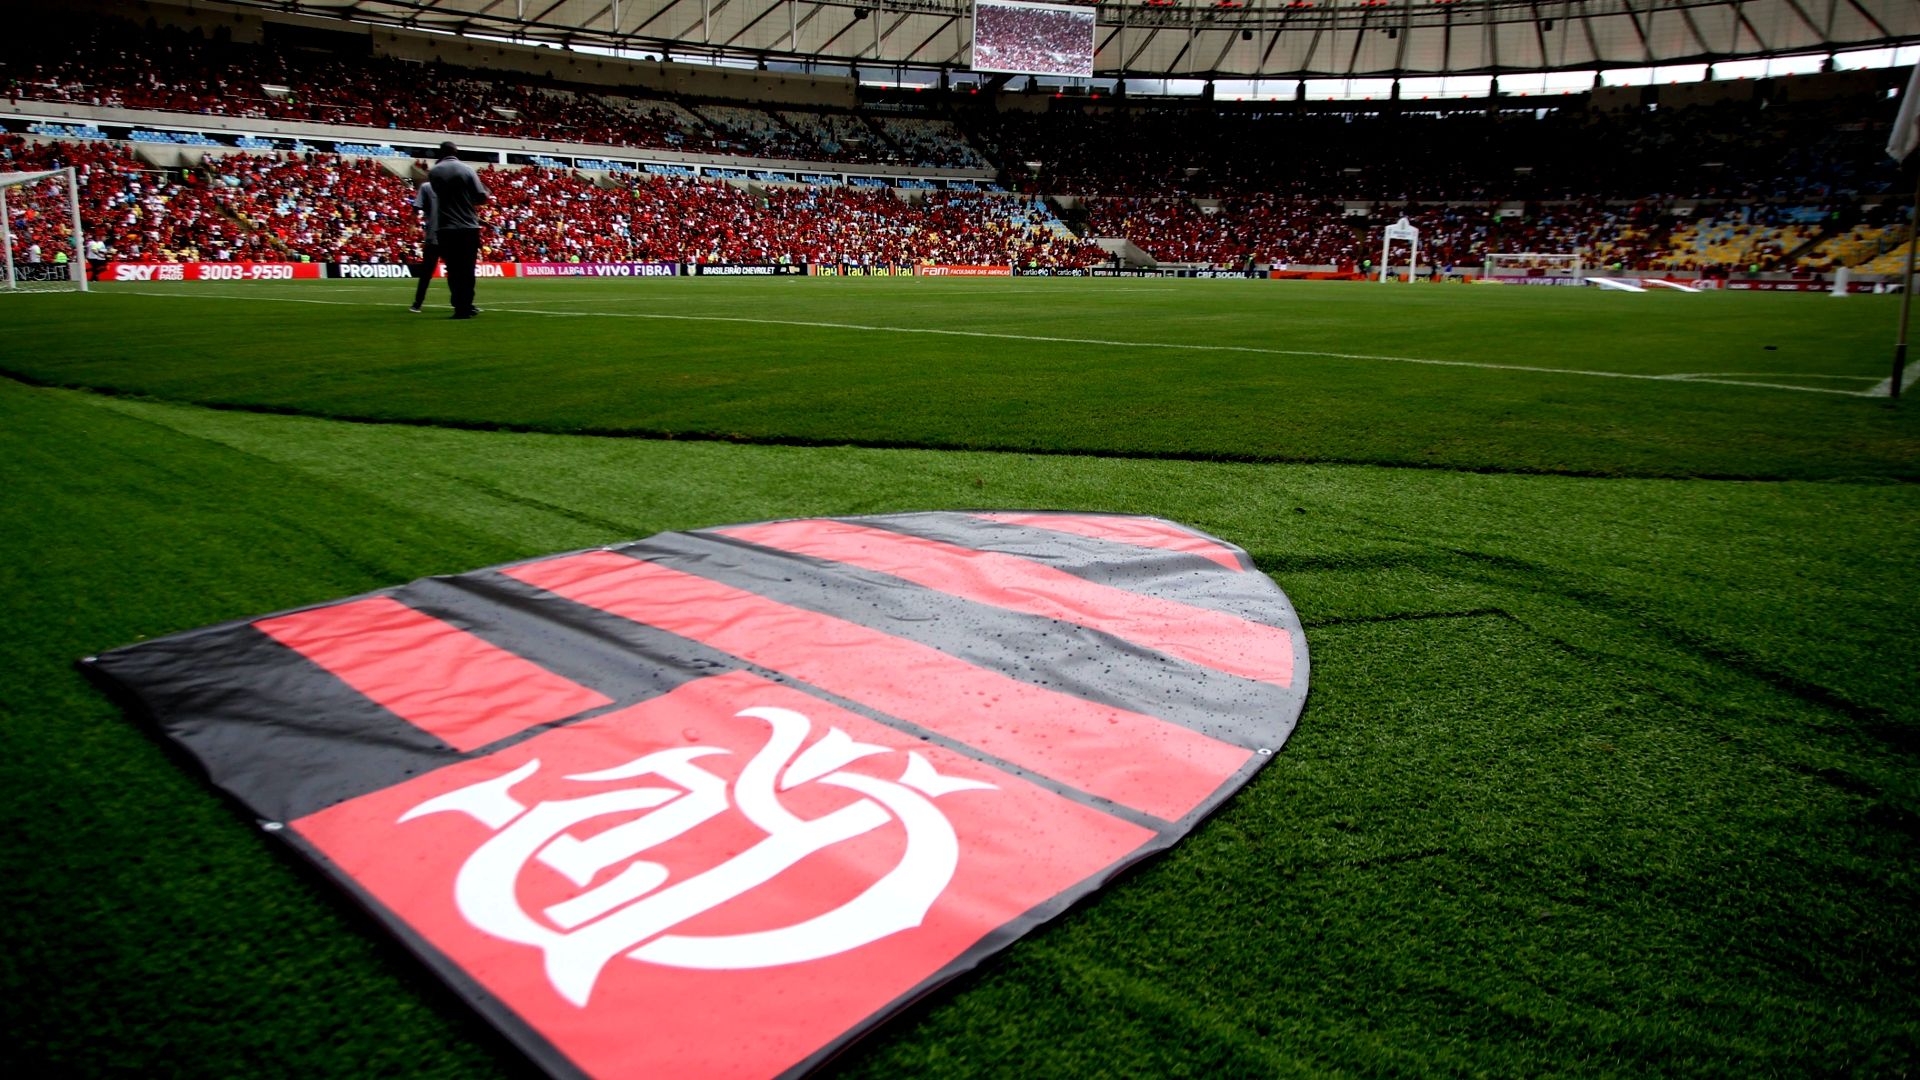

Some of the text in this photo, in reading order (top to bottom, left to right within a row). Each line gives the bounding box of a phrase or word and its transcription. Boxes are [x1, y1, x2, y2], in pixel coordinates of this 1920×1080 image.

[116, 264, 157, 281] SKY
[199, 264, 293, 280] 3003-9550
[440, 264, 504, 277] PBIDA
[526, 266, 556, 276] BANDA
[558, 266, 586, 276] LARGA
[595, 265, 631, 276] VIVO
[634, 265, 672, 276] FIBRA
[742, 266, 775, 275] CHEVROLET
[848, 265, 864, 277] taú
[870, 265, 890, 277] Itaú
[895, 265, 914, 277] Itaú
[1215, 271, 1247, 279] SOCIAL
